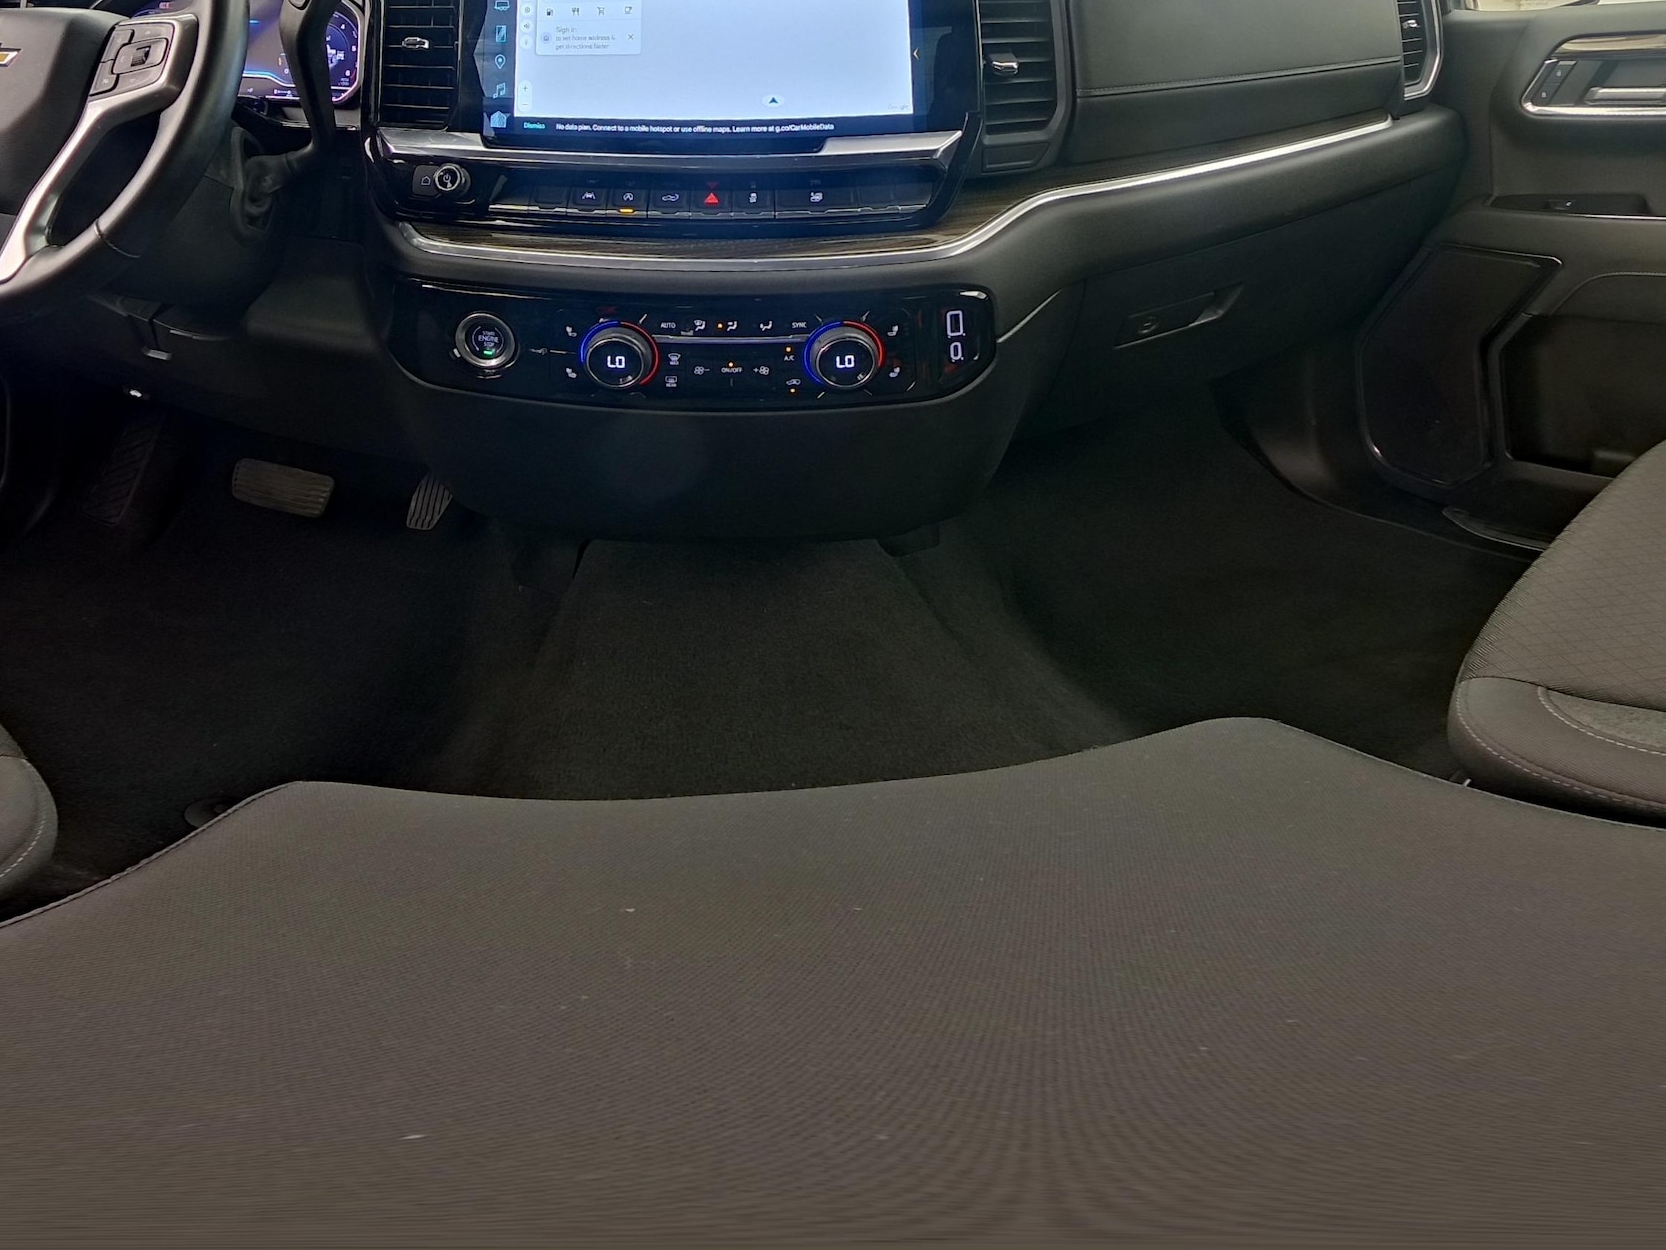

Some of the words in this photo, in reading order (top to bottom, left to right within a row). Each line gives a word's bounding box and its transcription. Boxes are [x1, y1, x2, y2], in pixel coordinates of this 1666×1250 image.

[556, 26, 569, 34] Sign
[650, 125, 672, 133] hotspot
[775, 124, 834, 133] g.co/CarMobileData
[478, 335, 499, 343] ENGINE
[607, 356, 625, 368] LO
[836, 355, 854, 368] LO
